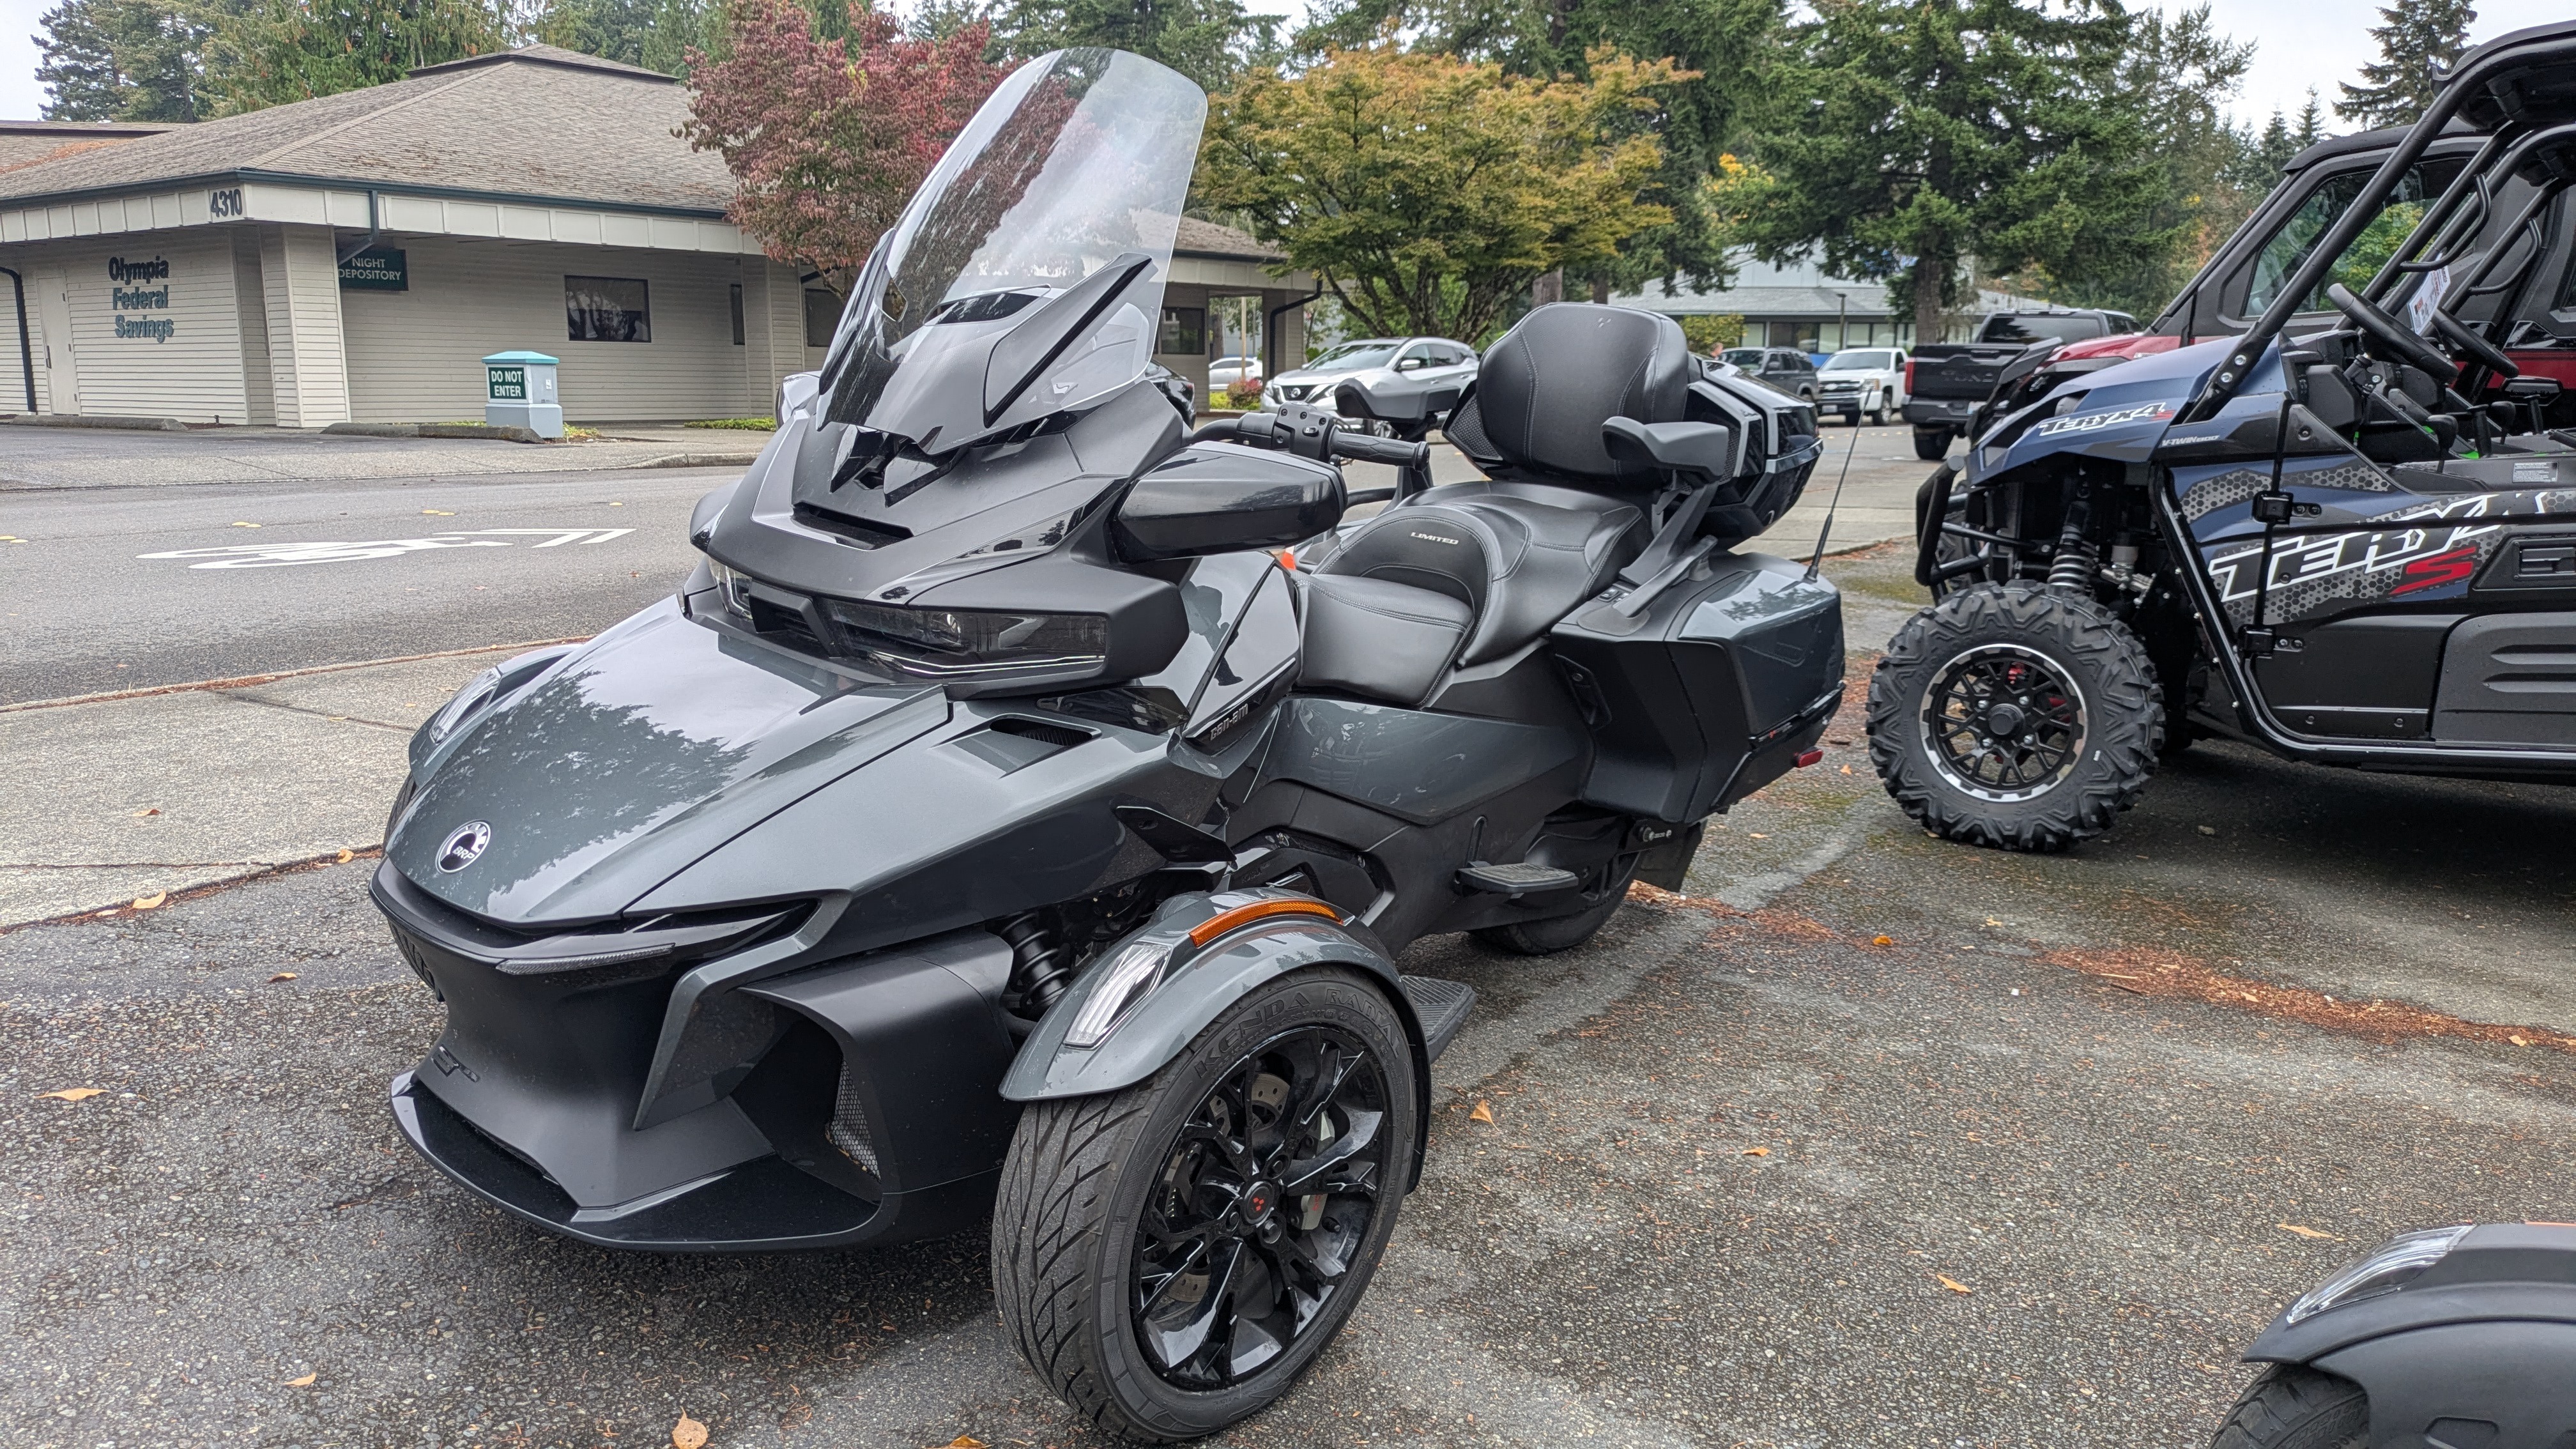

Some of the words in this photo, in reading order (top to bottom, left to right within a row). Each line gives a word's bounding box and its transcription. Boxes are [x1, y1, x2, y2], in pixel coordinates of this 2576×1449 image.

[211, 188, 243, 217] 4310
[351, 257, 385, 268] NIGHT
[109, 256, 169, 285] Olympia
[338, 269, 401, 280] DEPOSITORY
[112, 284, 169, 310] Federal
[115, 314, 174, 343] Savings
[491, 371, 503, 382] DO
[505, 371, 523, 383] NOT
[494, 385, 522, 397] ENTER
[1410, 532, 1459, 545] LIMITED
[452, 845, 475, 860] BRP
[1194, 992, 1310, 1078] KENDA
[1325, 988, 1400, 1060] RADIAL
